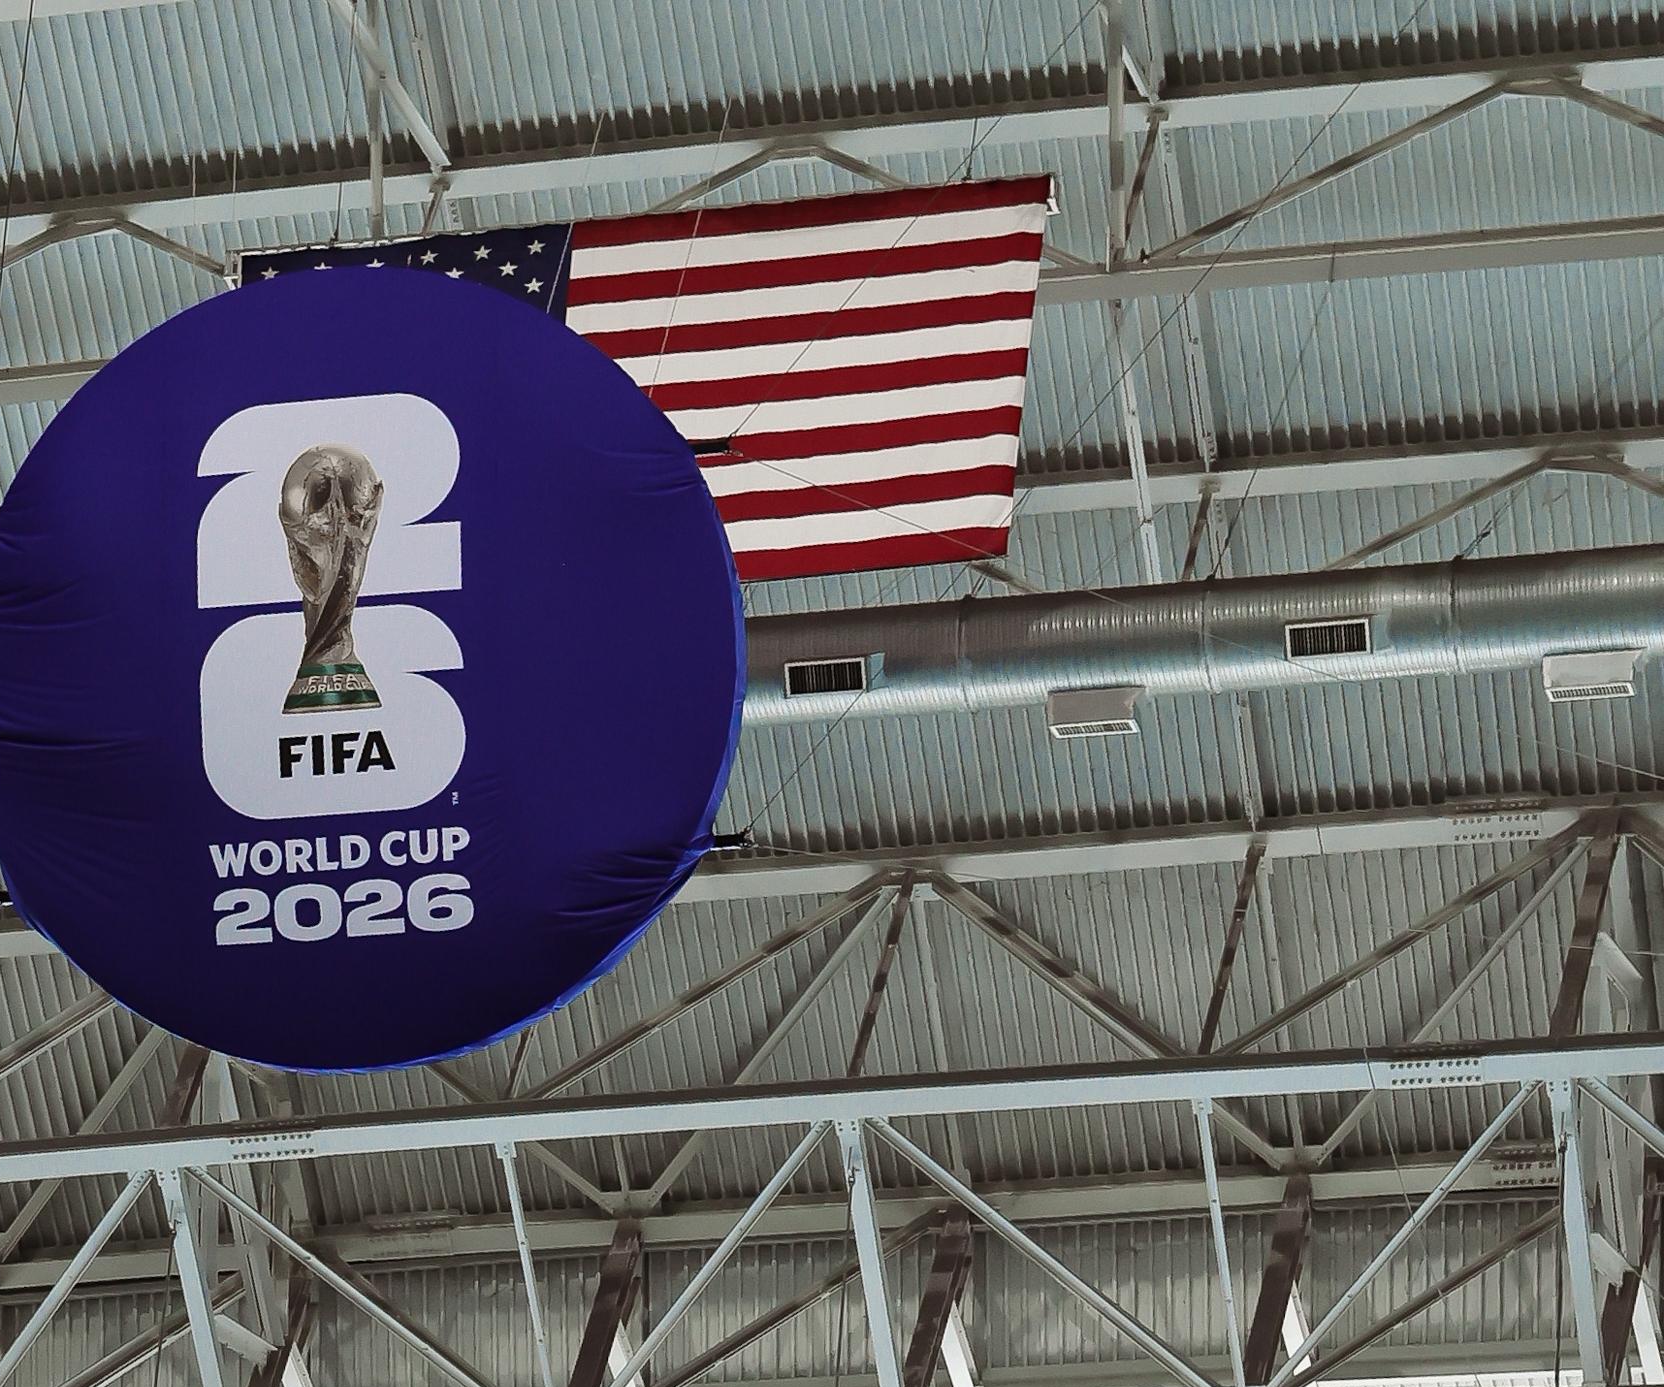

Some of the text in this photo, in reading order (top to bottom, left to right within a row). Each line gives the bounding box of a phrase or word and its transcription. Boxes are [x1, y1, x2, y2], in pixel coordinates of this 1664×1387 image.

[307, 673, 358, 686] FIFA
[279, 731, 396, 778] FIFA
[209, 827, 471, 878] WORLD CUP
[214, 873, 475, 946] 2026
